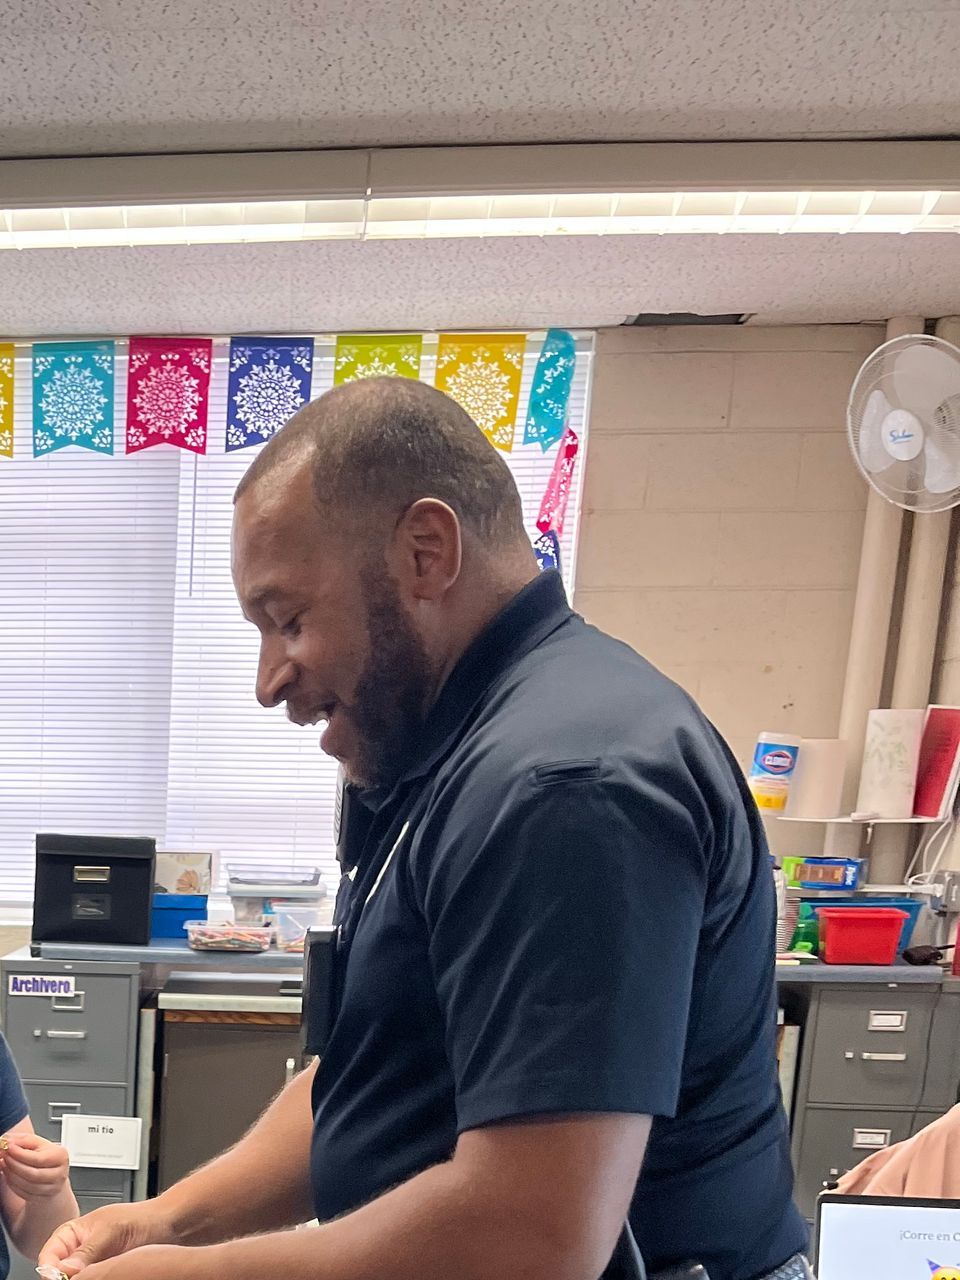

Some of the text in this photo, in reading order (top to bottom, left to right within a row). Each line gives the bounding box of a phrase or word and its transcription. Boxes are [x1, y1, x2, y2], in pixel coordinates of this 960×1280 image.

[12, 976, 71, 994] Archivero
[88, 1125, 99, 1134] mi
[936, 1232, 950, 1241] en
[952, 1232, 960, 1242] C
